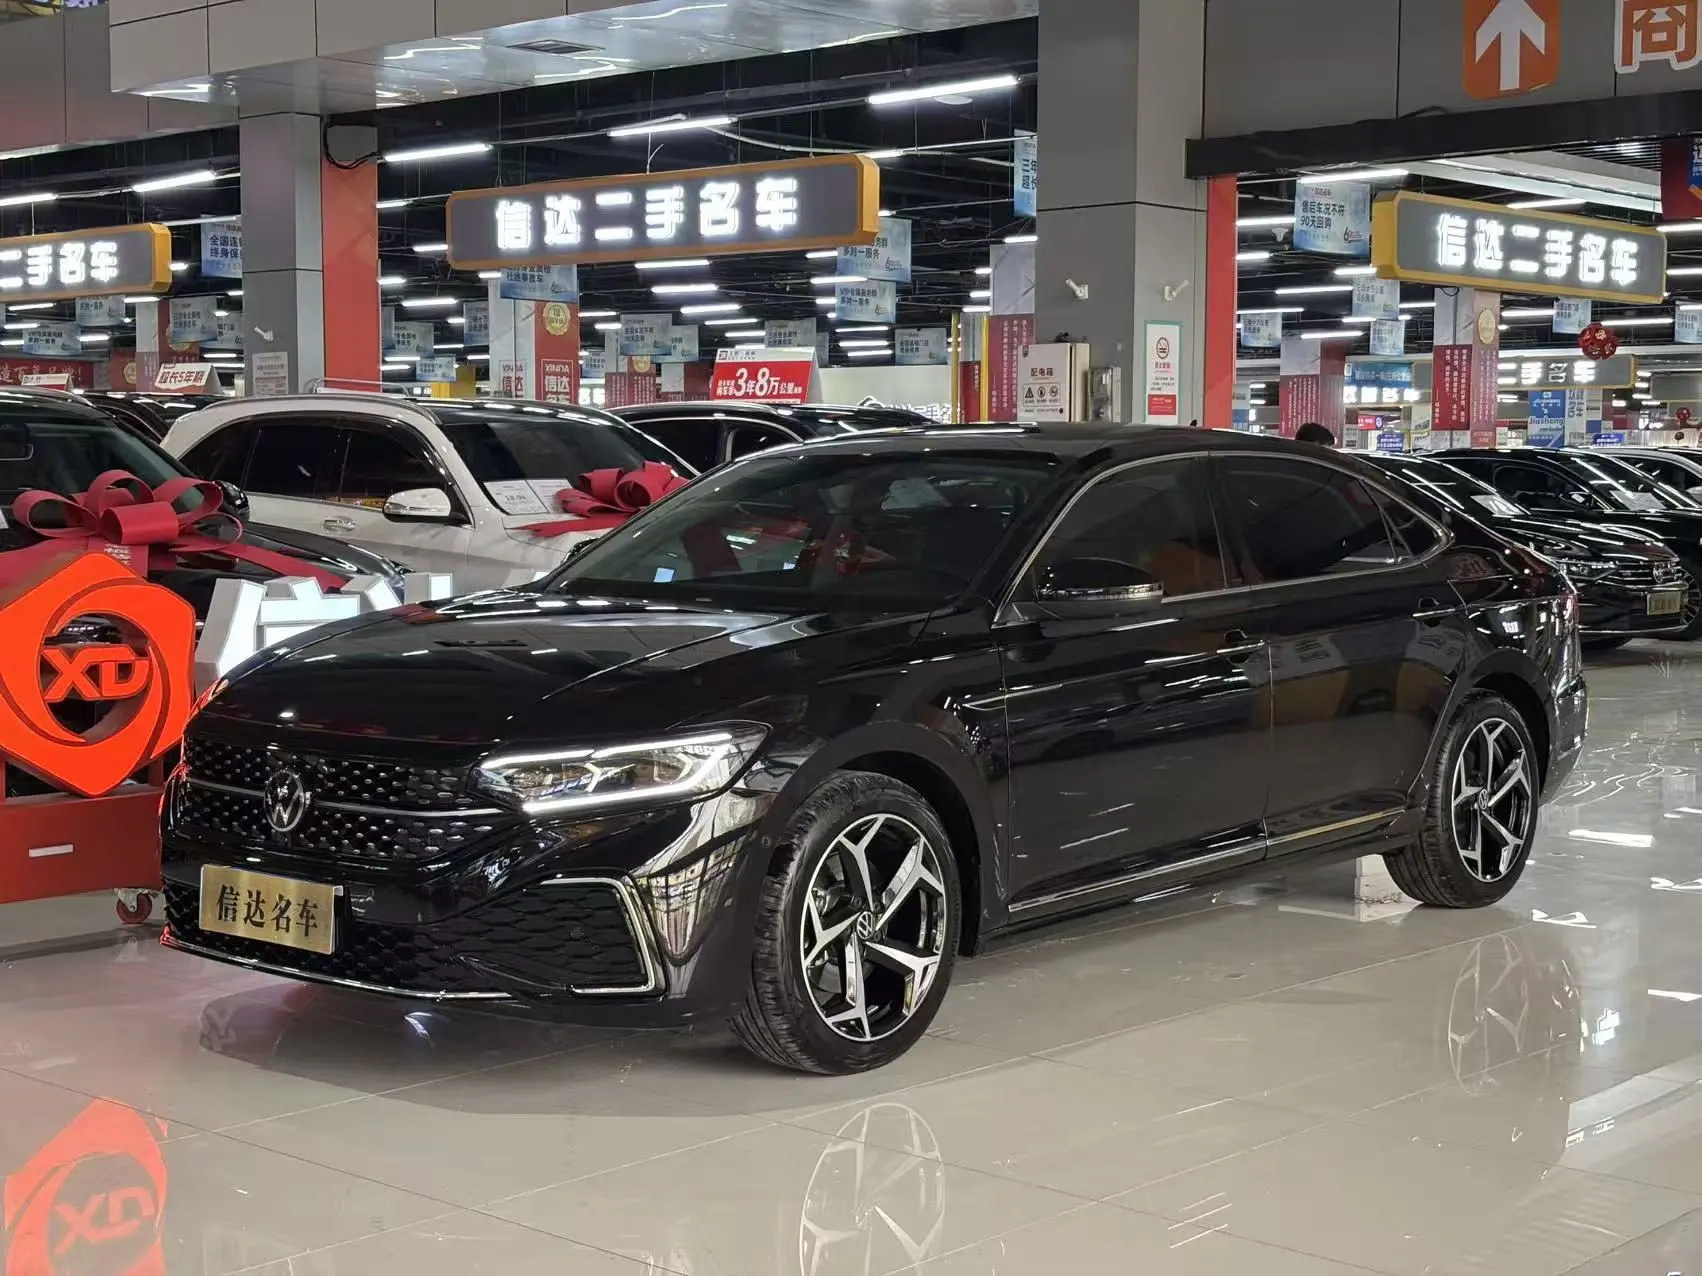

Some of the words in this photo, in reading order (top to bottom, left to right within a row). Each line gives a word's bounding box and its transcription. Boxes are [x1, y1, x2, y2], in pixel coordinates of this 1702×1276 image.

[496, 178, 798, 250] 信达二手名车
[1302, 199, 1345, 217] 售后车况不符
[1300, 215, 1332, 229] 90天回购
[210, 234, 241, 249] 全国连
[1437, 212, 1639, 286] 信达二手名车
[210, 247, 241, 259] 终身保
[843, 246, 880, 259] 多对一服务
[544, 363, 570, 373] XINDA
[1030, 367, 1054, 377] 配电箱
[544, 375, 570, 392] 信达
[41, 647, 150, 700] XD
[216, 884, 319, 938] 信达名车
